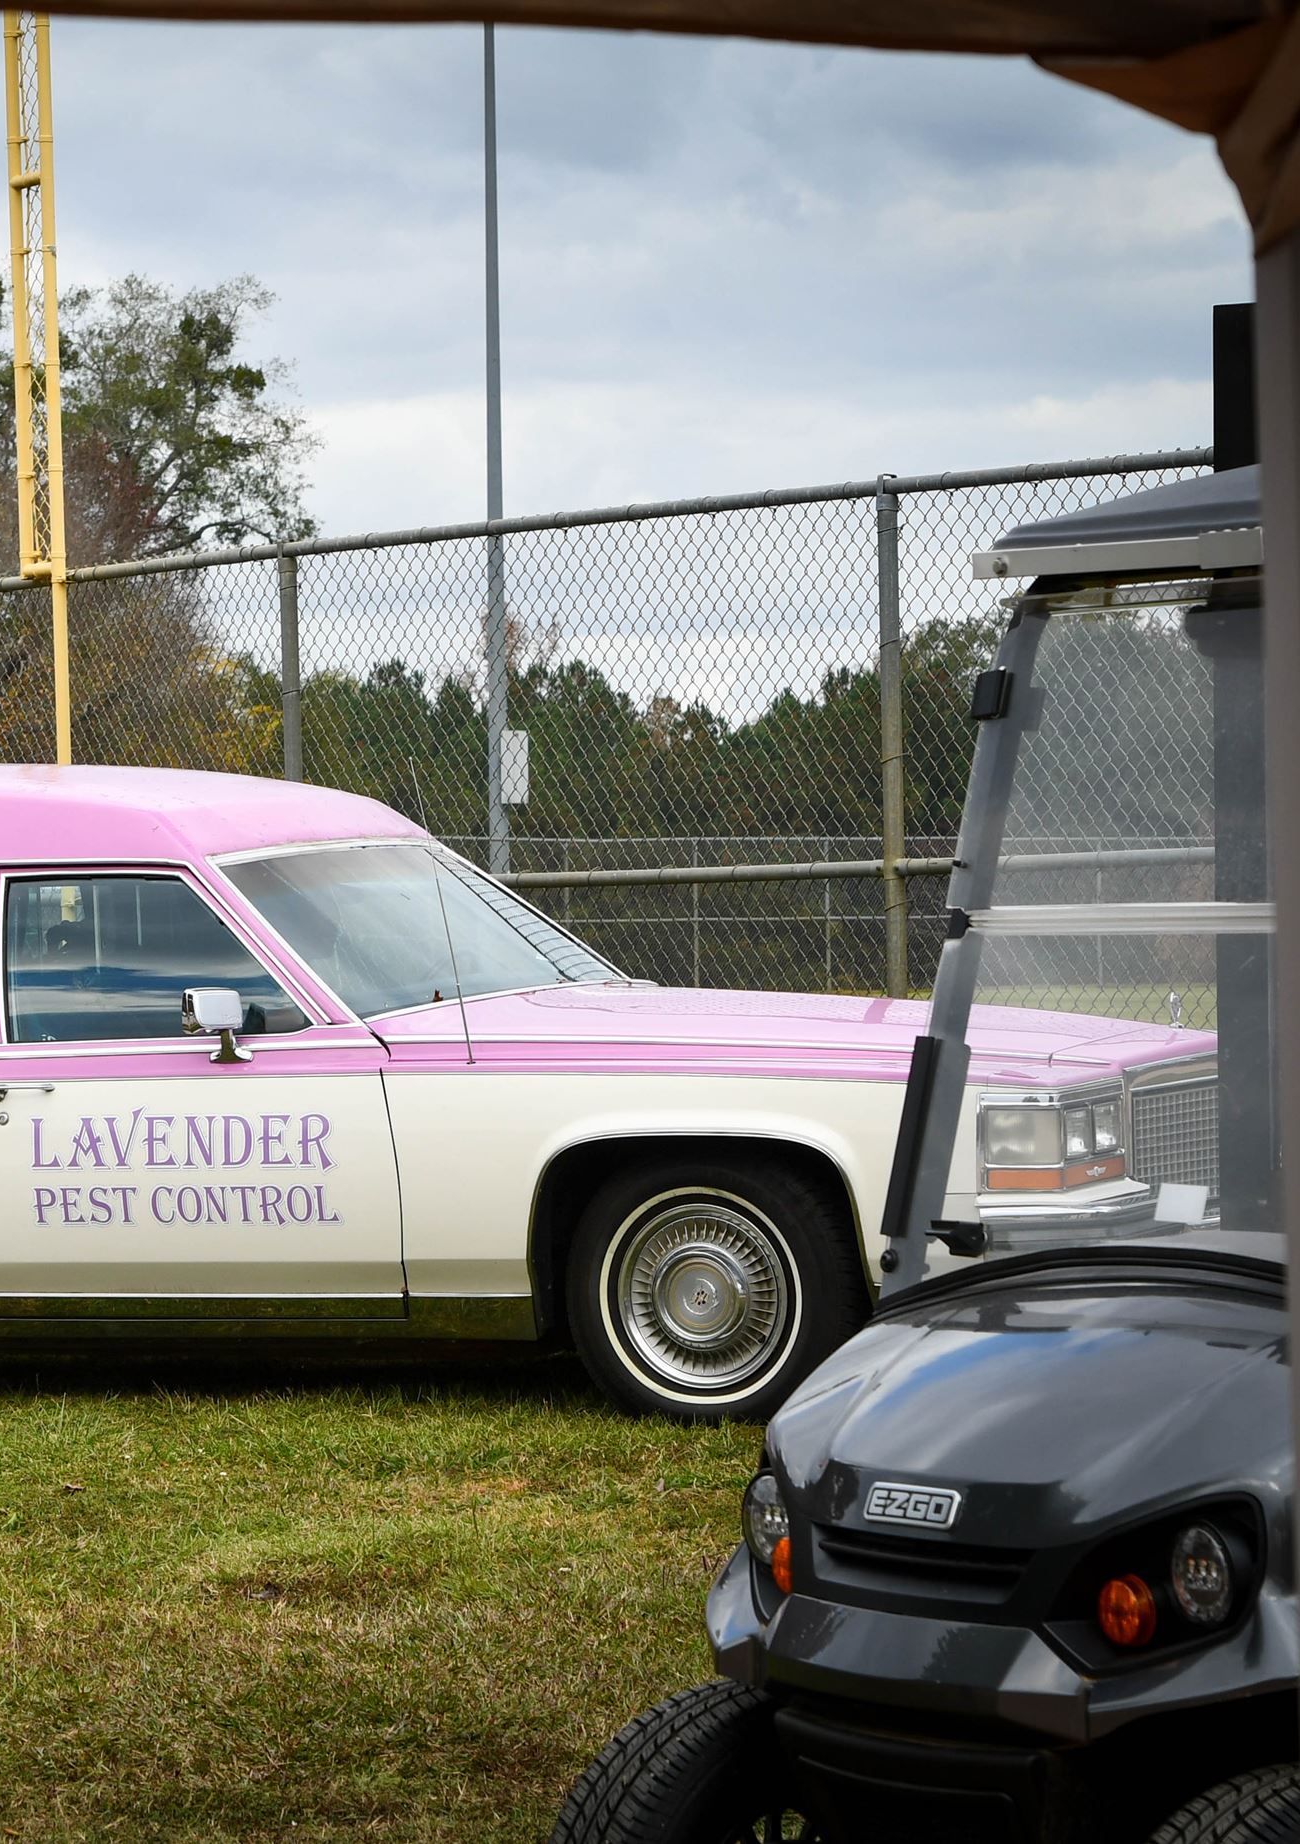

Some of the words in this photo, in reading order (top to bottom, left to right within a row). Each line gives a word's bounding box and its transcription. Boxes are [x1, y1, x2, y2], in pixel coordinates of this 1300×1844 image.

[31, 1105, 337, 1173] LAVENDER
[33, 1185, 139, 1225] PEST
[150, 1184, 343, 1226] CONTROL
